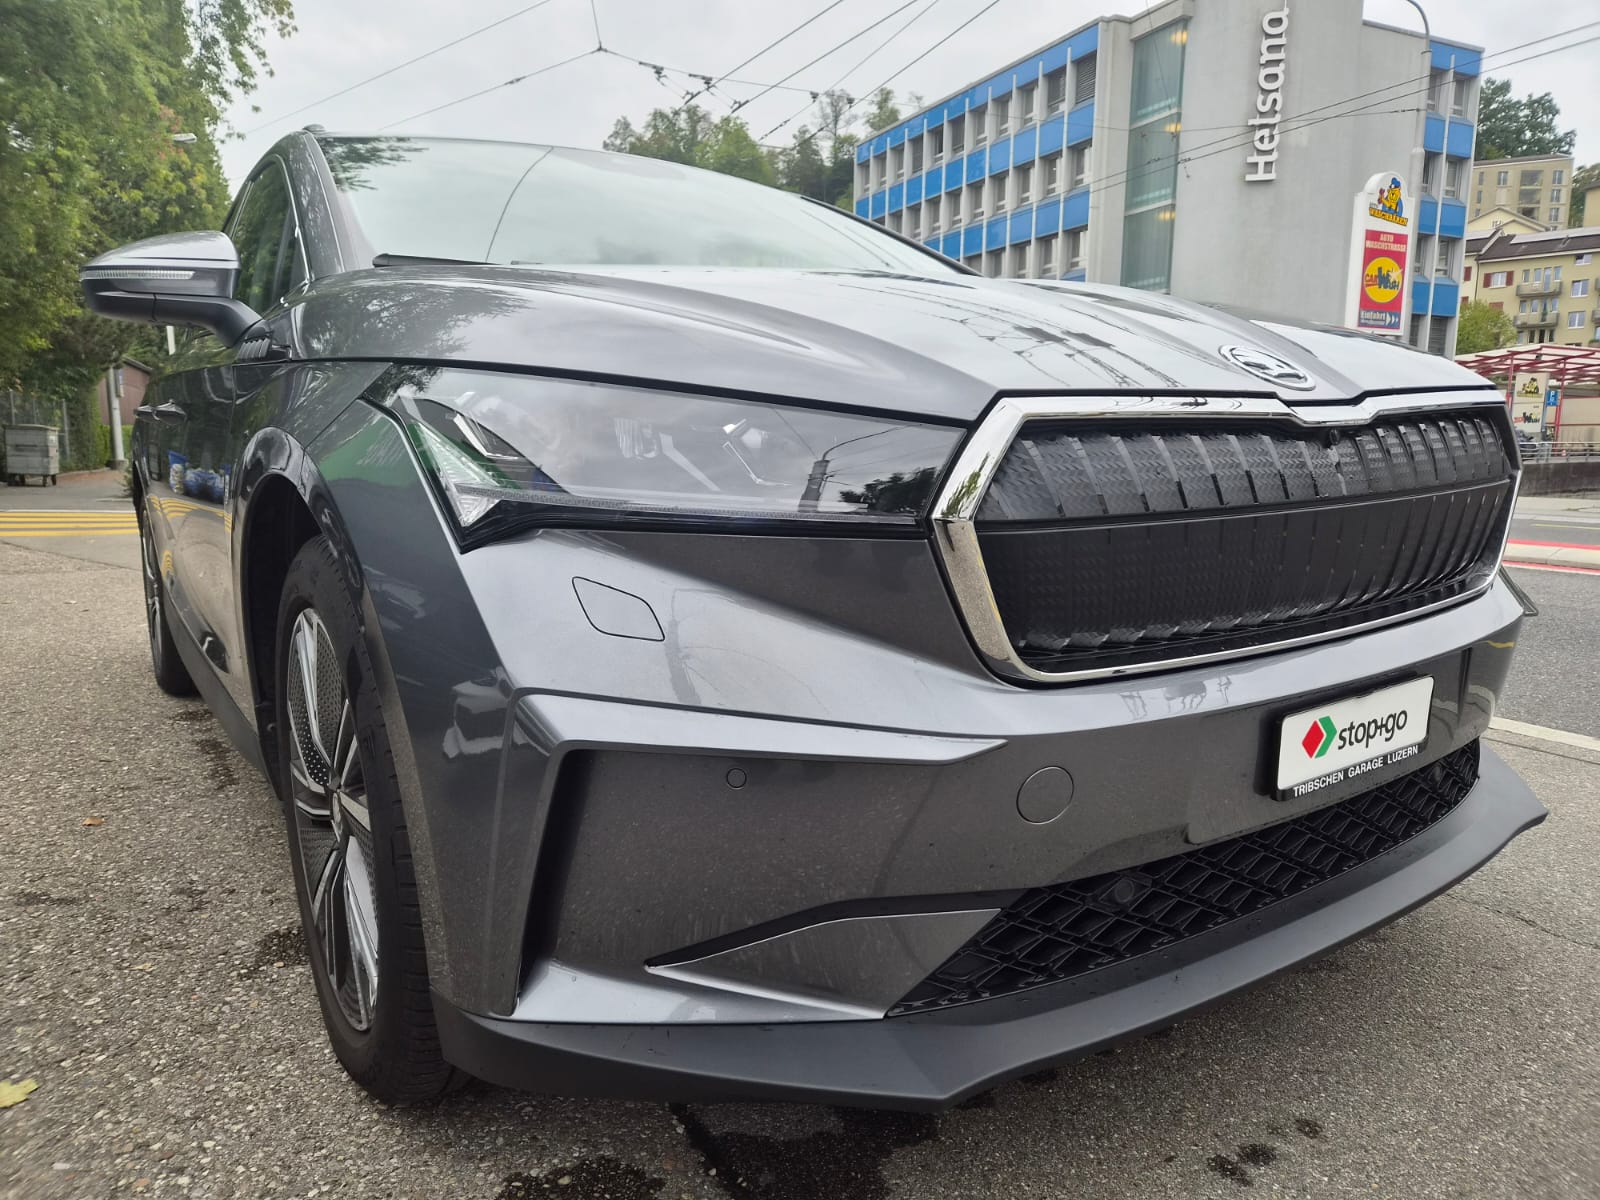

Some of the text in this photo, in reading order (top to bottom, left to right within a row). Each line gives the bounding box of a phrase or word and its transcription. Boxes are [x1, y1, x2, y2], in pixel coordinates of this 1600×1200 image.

[1245, 8, 1289, 181] Helsana
[1338, 710, 1407, 750] stop+go
[1293, 745, 1419, 797] TRIBSCHEN GARAGE LUZERN
